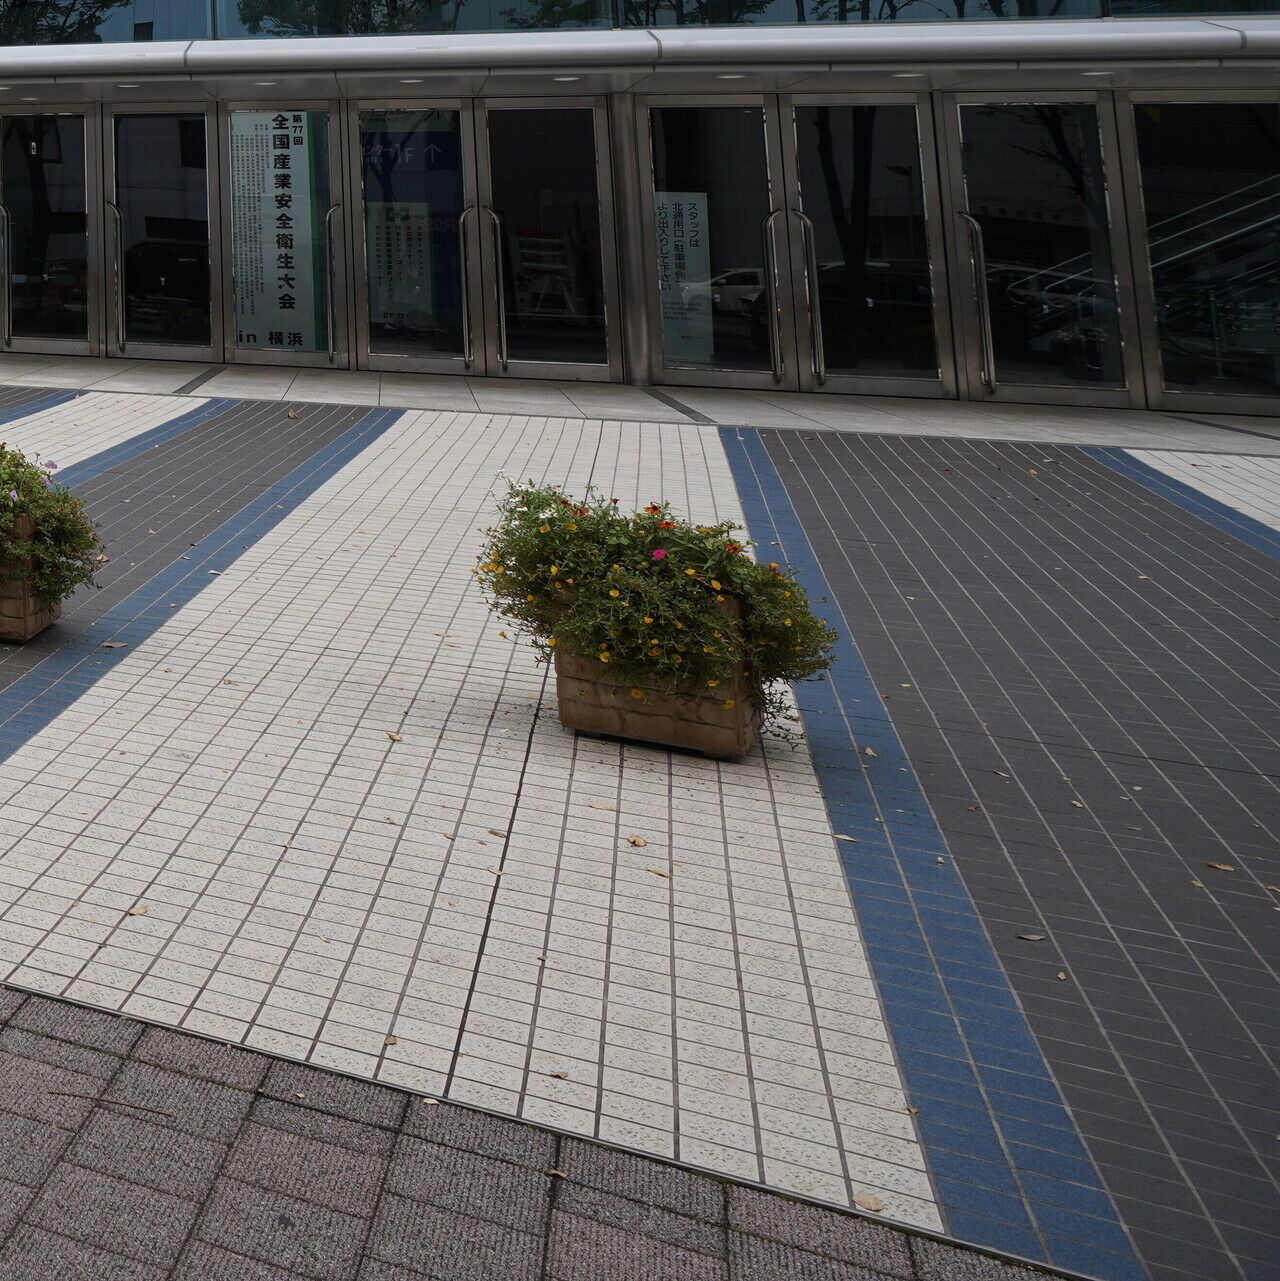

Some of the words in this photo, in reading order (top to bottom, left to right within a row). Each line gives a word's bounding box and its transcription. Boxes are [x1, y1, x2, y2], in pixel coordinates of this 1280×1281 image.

[292, 114, 304, 146] 第77回
[271, 113, 297, 311] 全国産業安全衛生大会
[688, 202, 700, 248] スタッフは
[268, 330, 303, 346] 横浜
